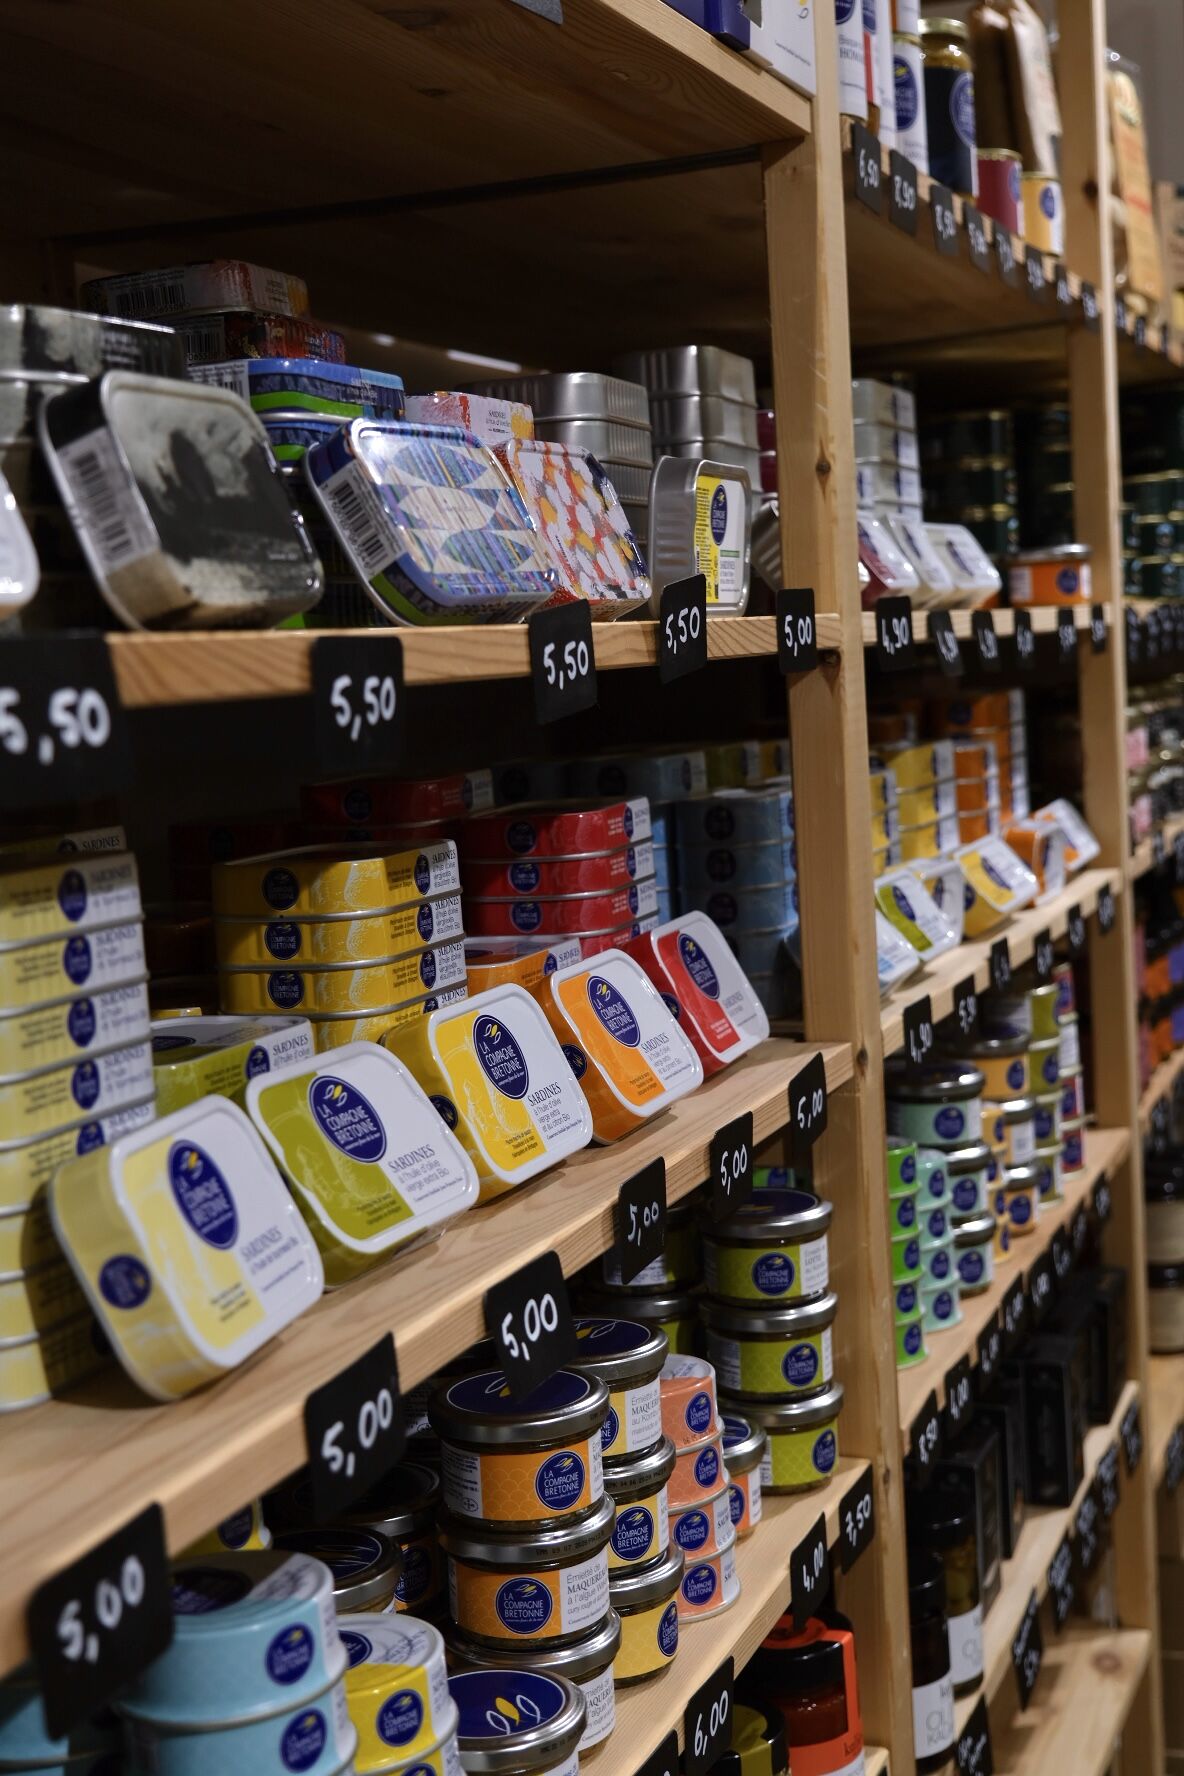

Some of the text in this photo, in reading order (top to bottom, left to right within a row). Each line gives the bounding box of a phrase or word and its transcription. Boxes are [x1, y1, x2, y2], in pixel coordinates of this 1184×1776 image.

[665, 606, 700, 655] 5,50
[785, 614, 812, 657] 5,00
[881, 616, 909, 655] 4,90
[543, 640, 589, 691] 5,50
[331, 675, 396, 741] 5,50
[0, 688, 110, 763] 5,50
[272, 1034, 308, 1056] SARDINES
[479, 1041, 491, 1054] LA
[641, 1032, 671, 1054] SARDINES
[491, 1057, 523, 1080] BRETONNE
[528, 1081, 562, 1107] SARDINES
[317, 1104, 333, 1118] LA
[797, 1088, 823, 1130] 5,00
[388, 1144, 435, 1173] SARDINES
[719, 1144, 748, 1196] 5,00
[627, 1202, 659, 1246] 5,00
[501, 1293, 559, 1361] 5,00
[321, 1388, 393, 1476] 5,00
[544, 1470, 554, 1479] LA
[544, 1472, 579, 1488] COMPAGNIE
[545, 1481, 579, 1497] BRETONNE
[617, 1523, 626, 1533] LA
[617, 1525, 648, 1540] COMPAGNIE
[845, 1493, 871, 1547] 7,50
[618, 1534, 649, 1549] BRETONNE
[802, 1541, 824, 1592] 4,00
[58, 1556, 144, 1661] 5,00
[503, 1592, 514, 1601] LA
[503, 1600, 544, 1610] COMPAGNIE
[504, 1609, 544, 1618] BRETONNE
[694, 1690, 728, 1757] 6,00
